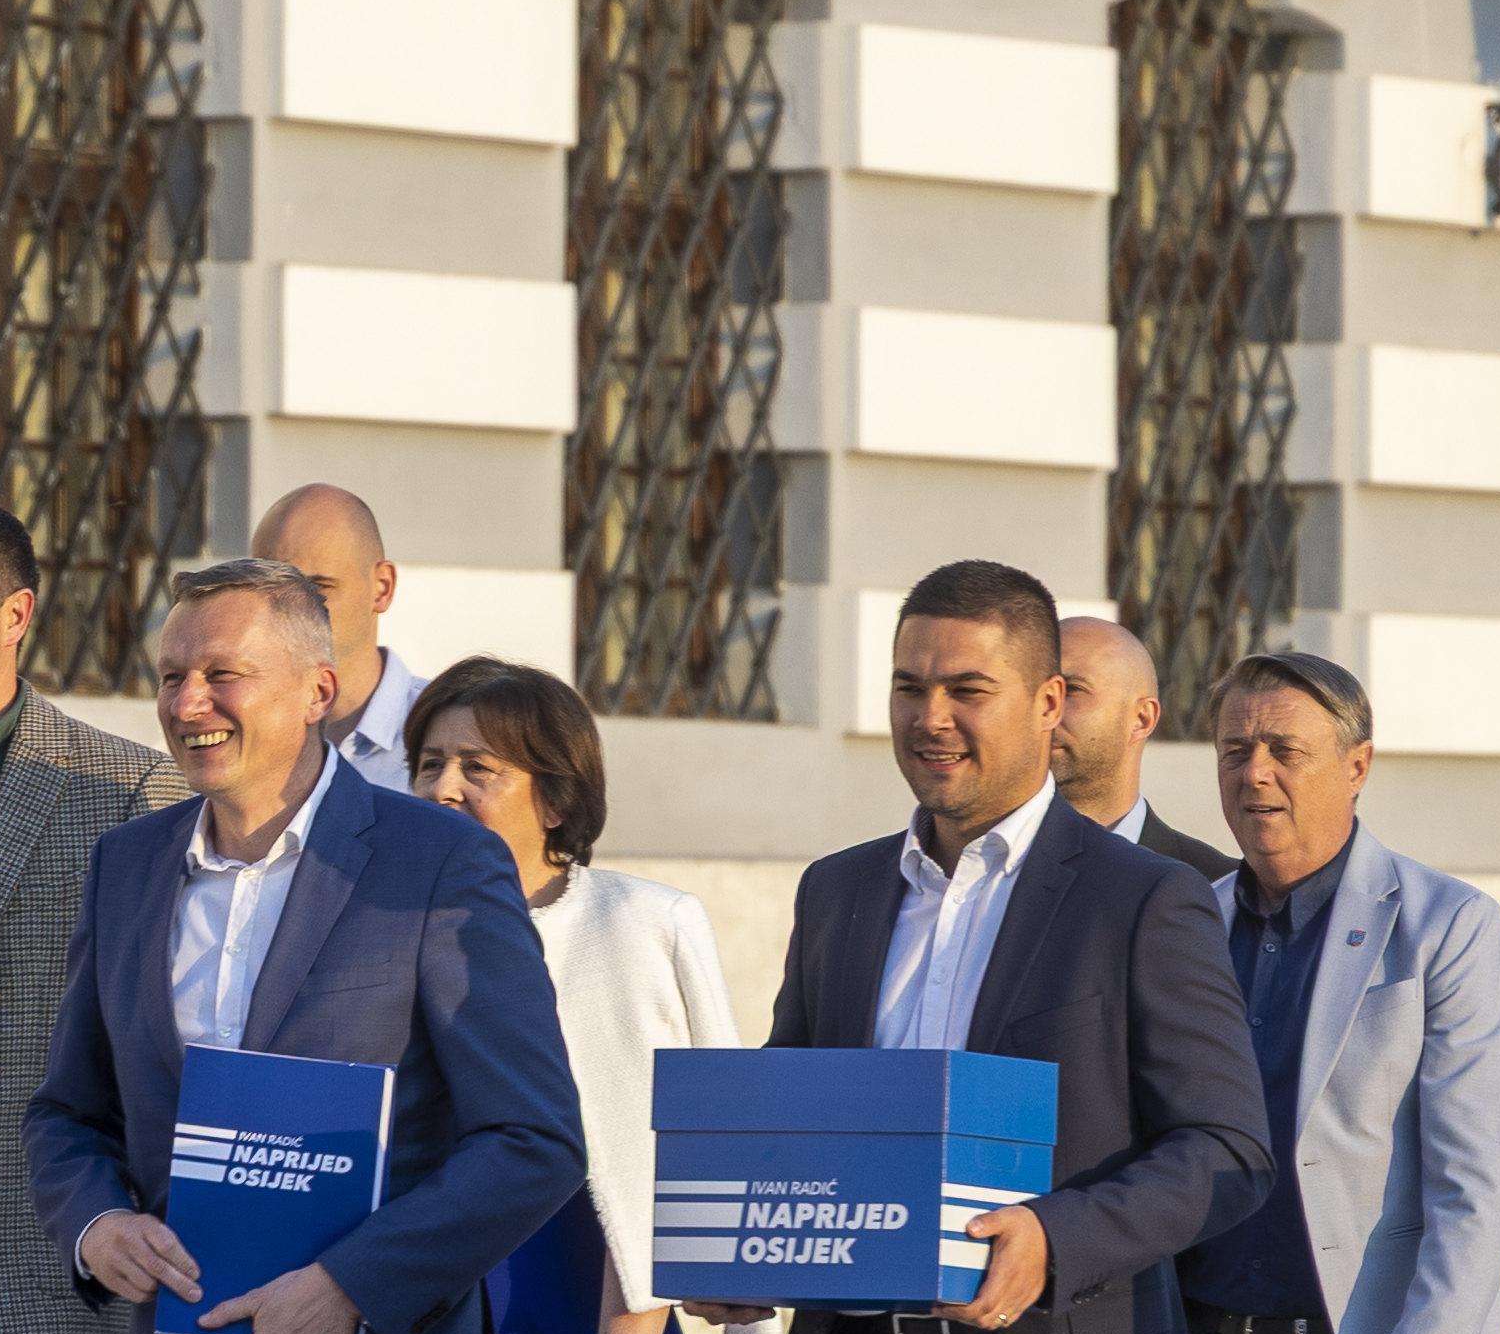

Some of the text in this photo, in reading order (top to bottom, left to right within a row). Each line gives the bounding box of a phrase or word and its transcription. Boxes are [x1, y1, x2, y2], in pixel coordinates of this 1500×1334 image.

[238, 1130, 304, 1148] IVAN RADIĆ
[232, 1144, 354, 1174] NAPRIJED
[227, 1167, 315, 1192] OSIJEK
[750, 1178, 839, 1196] IVAN RADIĆ
[745, 1202, 909, 1230] NAPRIJED
[740, 1236, 857, 1264] OSIJEK
